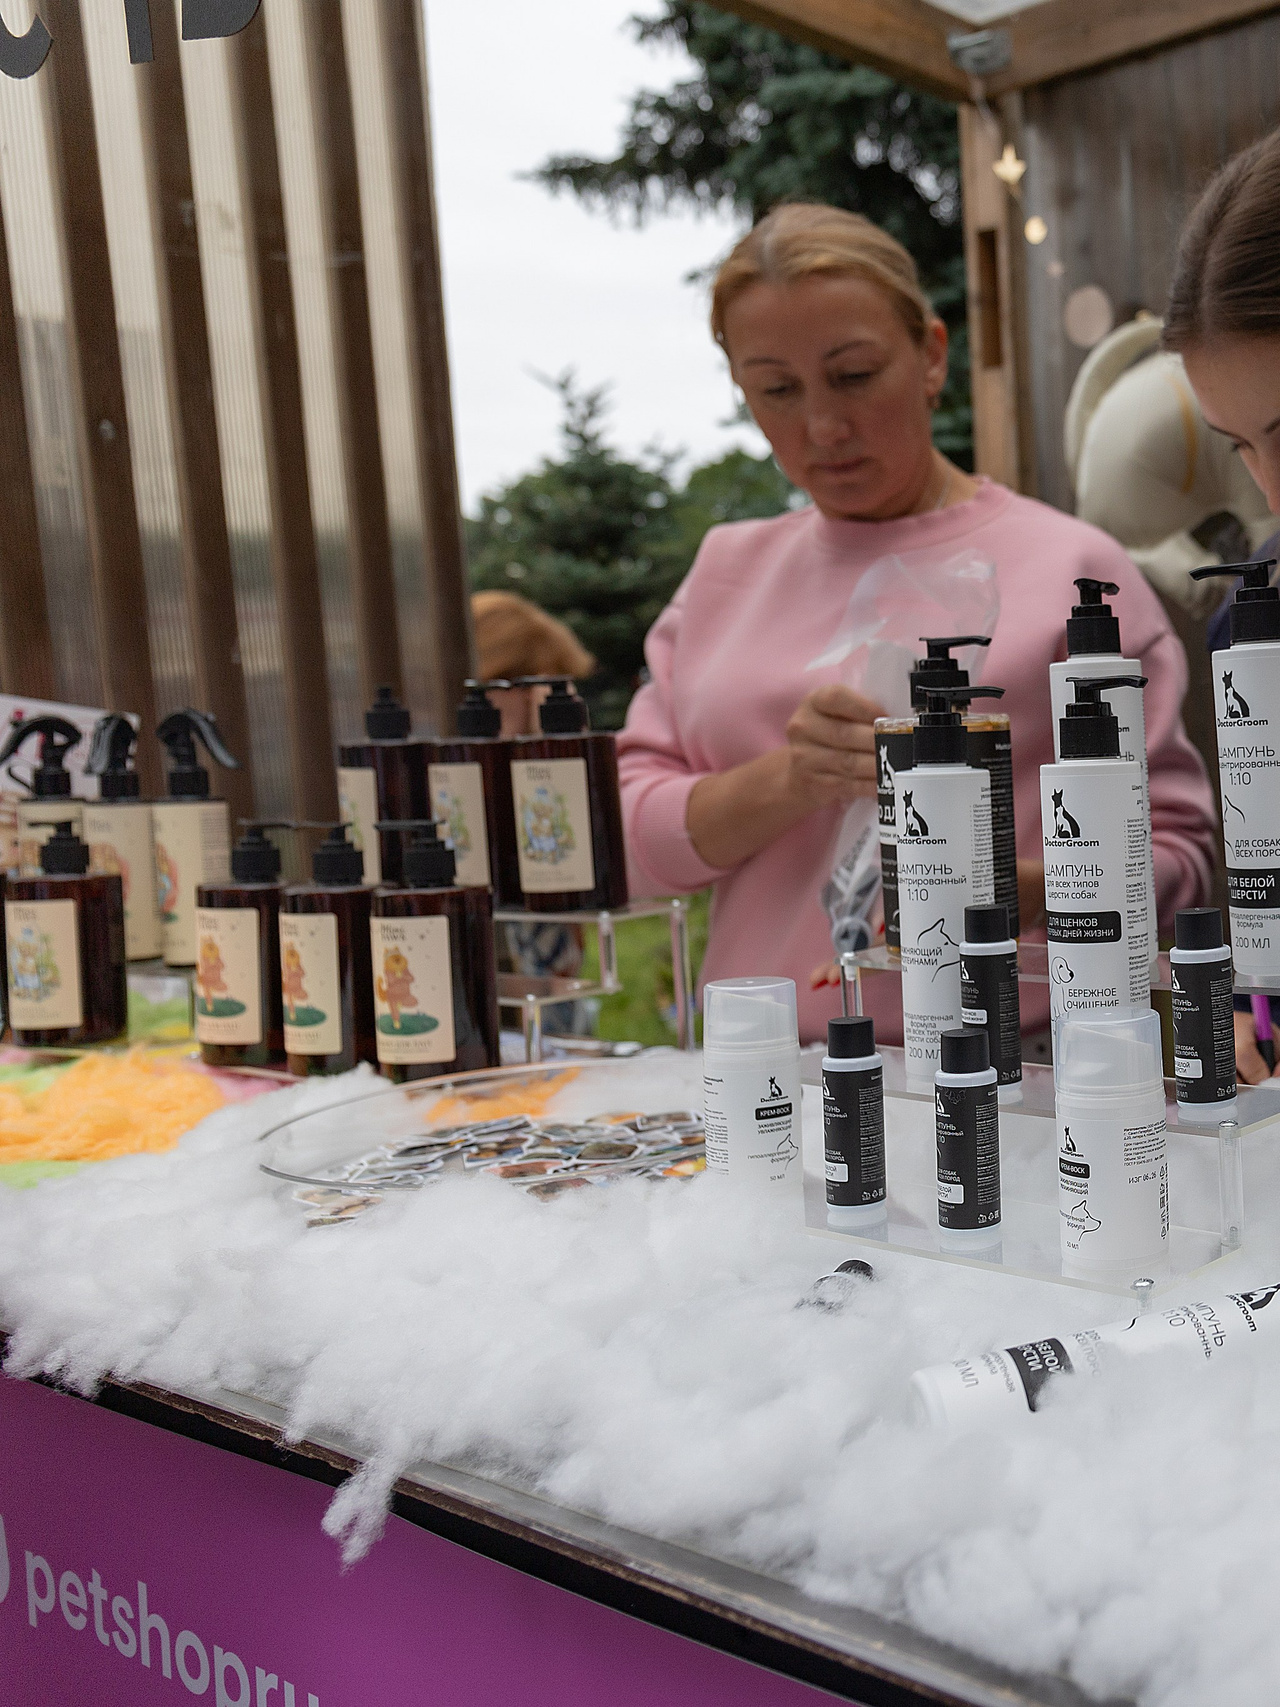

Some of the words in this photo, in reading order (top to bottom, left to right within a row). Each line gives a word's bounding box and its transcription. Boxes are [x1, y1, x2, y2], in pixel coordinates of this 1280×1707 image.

[1229, 772, 1251, 785] 1:10
[1235, 839, 1250, 848] ДЛЯ
[1236, 849, 1254, 858] ВСЕХ
[1055, 880, 1071, 888] всех
[1072, 880, 1100, 888] типов
[1239, 875, 1275, 888] БЕЛОЙ
[907, 888, 929, 901] 1:10
[1071, 890, 1098, 899] собак
[1231, 890, 1267, 900] ШЕРСТИ
[1060, 918, 1098, 927] ЩЕНКОВ
[1236, 921, 1264, 930] формула
[1062, 929, 1082, 938] ДНЕЙ
[1083, 929, 1114, 938] ЖИЗНИ
[1235, 936, 1249, 948] 200
[1252, 938, 1271, 948] МЛ
[1068, 988, 1117, 998] БЕРЕЖНОЕ
[909, 1047, 923, 1058] 200
